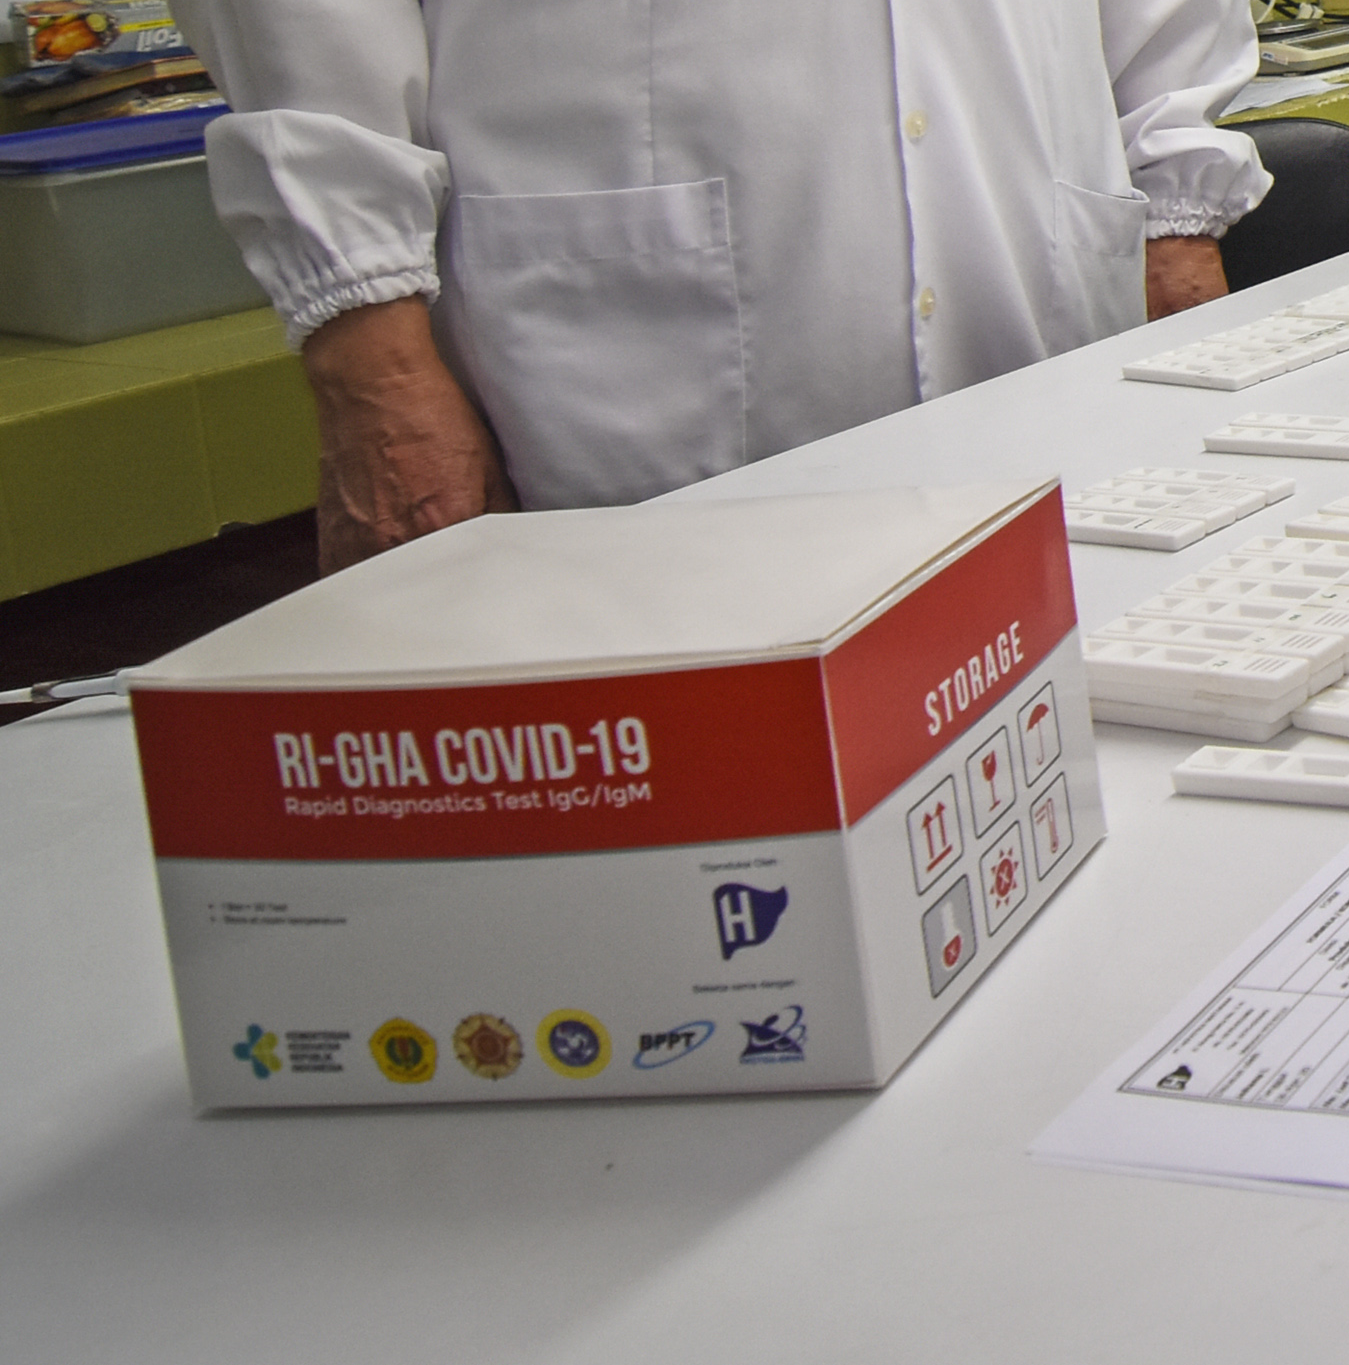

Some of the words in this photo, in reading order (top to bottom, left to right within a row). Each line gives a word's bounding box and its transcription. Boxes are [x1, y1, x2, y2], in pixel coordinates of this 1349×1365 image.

[923, 620, 1025, 738] STORAGE
[273, 731, 430, 789] RI-GHA
[434, 716, 653, 786] COVID-19
[284, 796, 348, 818] Rapid
[353, 792, 488, 818] Diagnostics
[493, 789, 543, 811] Test
[548, 782, 653, 812] IgG/IgM
[639, 1031, 697, 1053] BPPT
